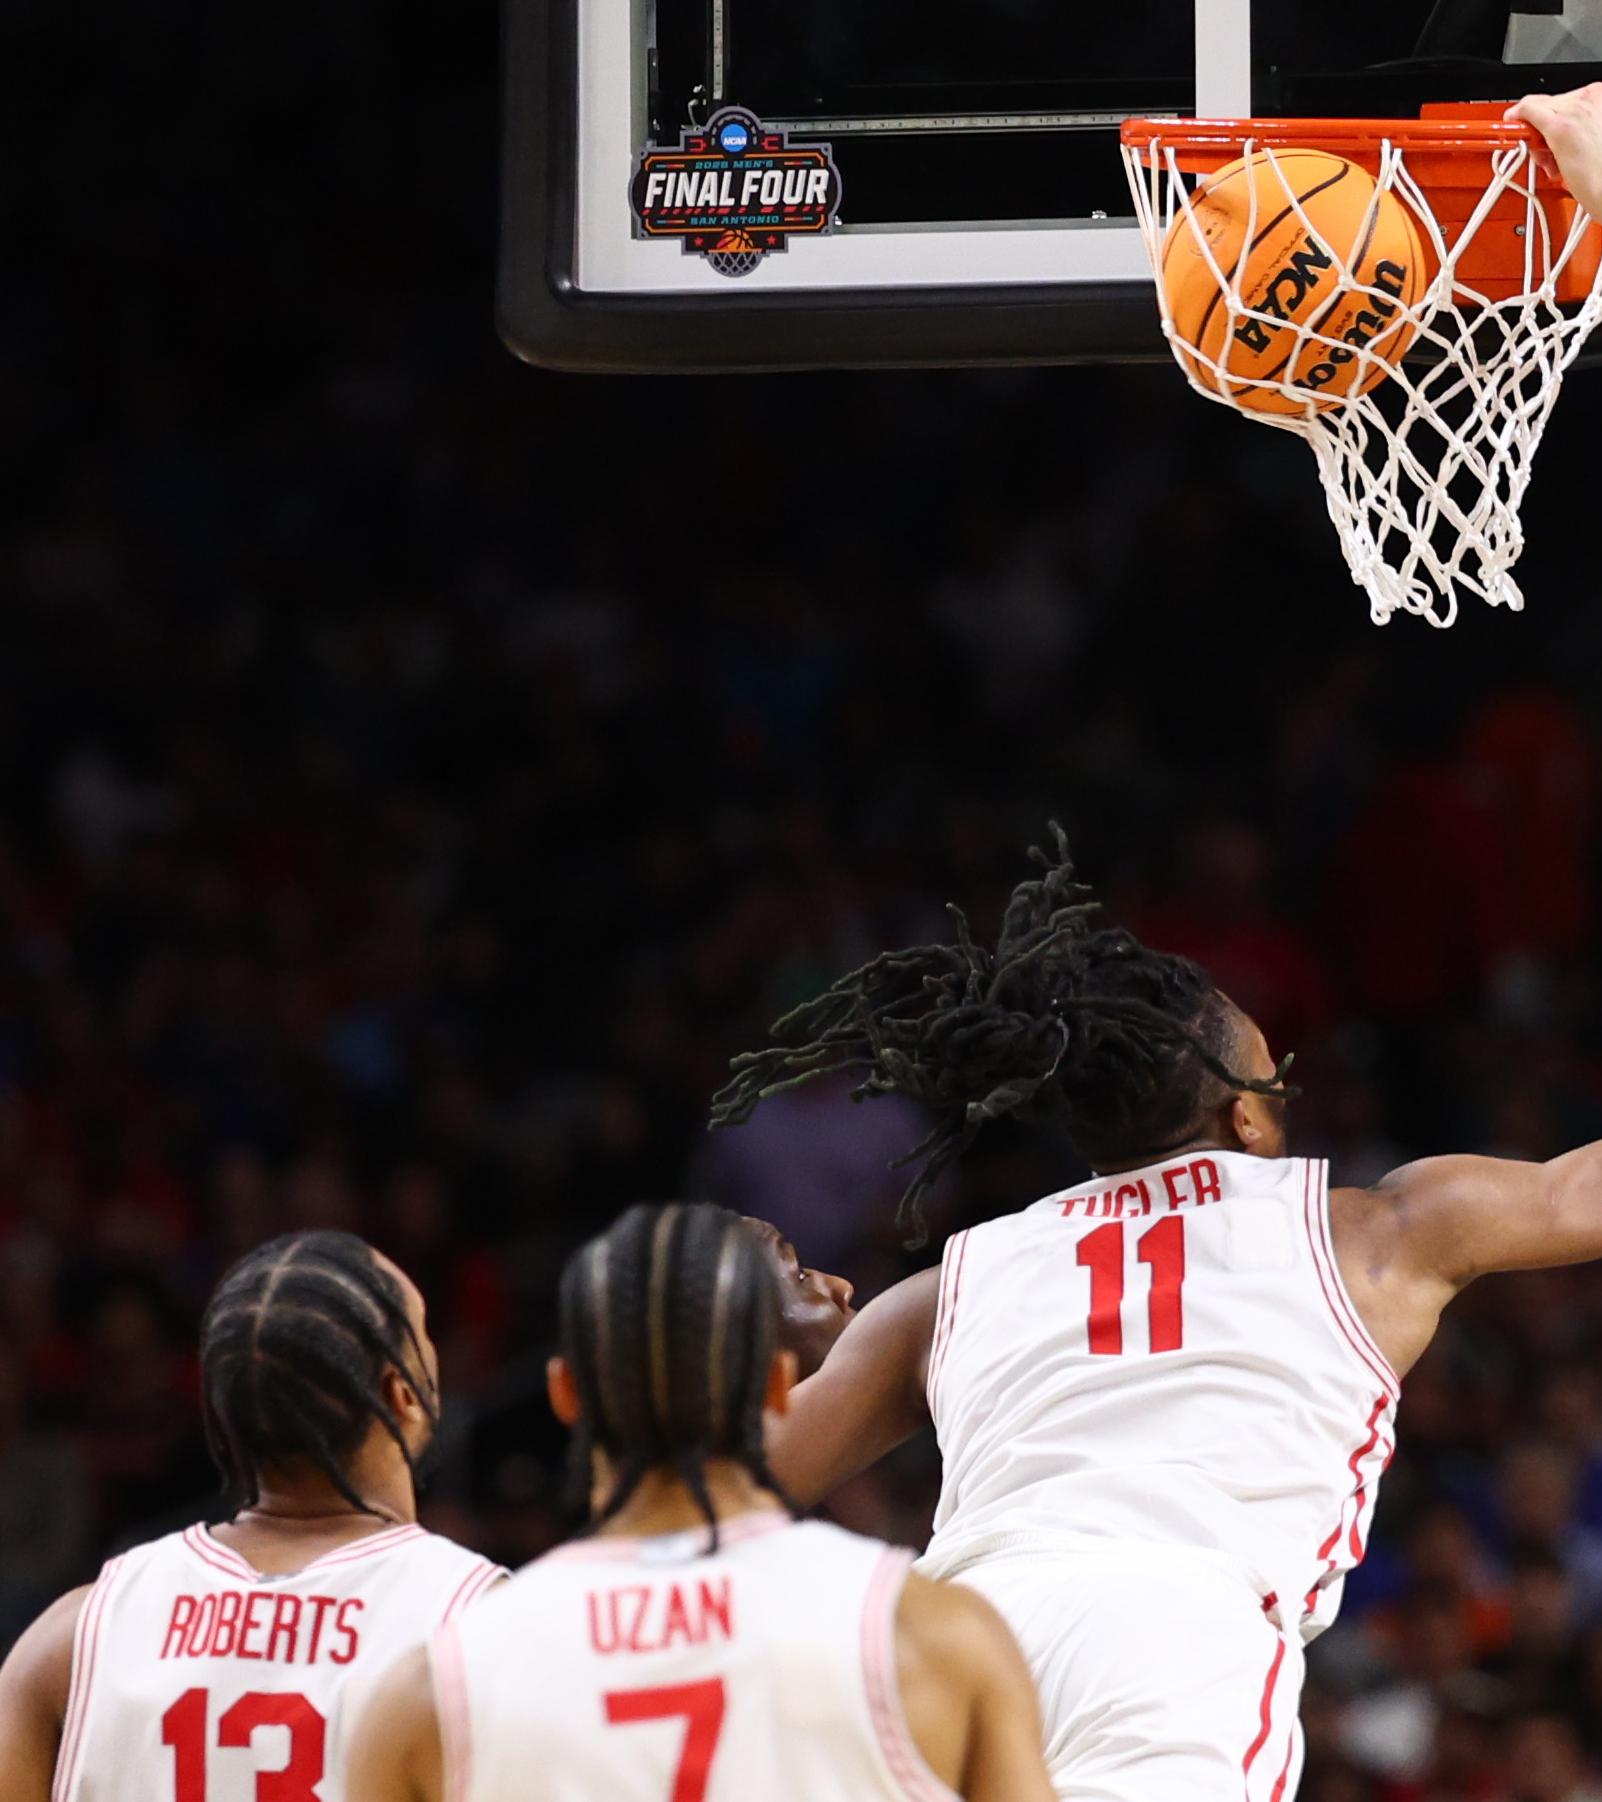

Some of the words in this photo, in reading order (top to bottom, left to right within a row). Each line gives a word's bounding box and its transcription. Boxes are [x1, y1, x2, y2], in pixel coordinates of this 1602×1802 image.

[722, 136, 747, 146] NCAA
[733, 159, 774, 169] MEN'S
[644, 171, 735, 208] FINAL
[741, 169, 830, 206] FOUR
[690, 216, 717, 225] SAN
[721, 214, 780, 225] ANTONIO
[1233, 235, 1333, 354] NCAA
[1076, 1215, 1185, 1355] 11
[160, 1590, 365, 1665] ROBERTS
[586, 1574, 733, 1655] UZAN
[162, 1687, 327, 1802] 13
[602, 1675, 727, 1802] 7
